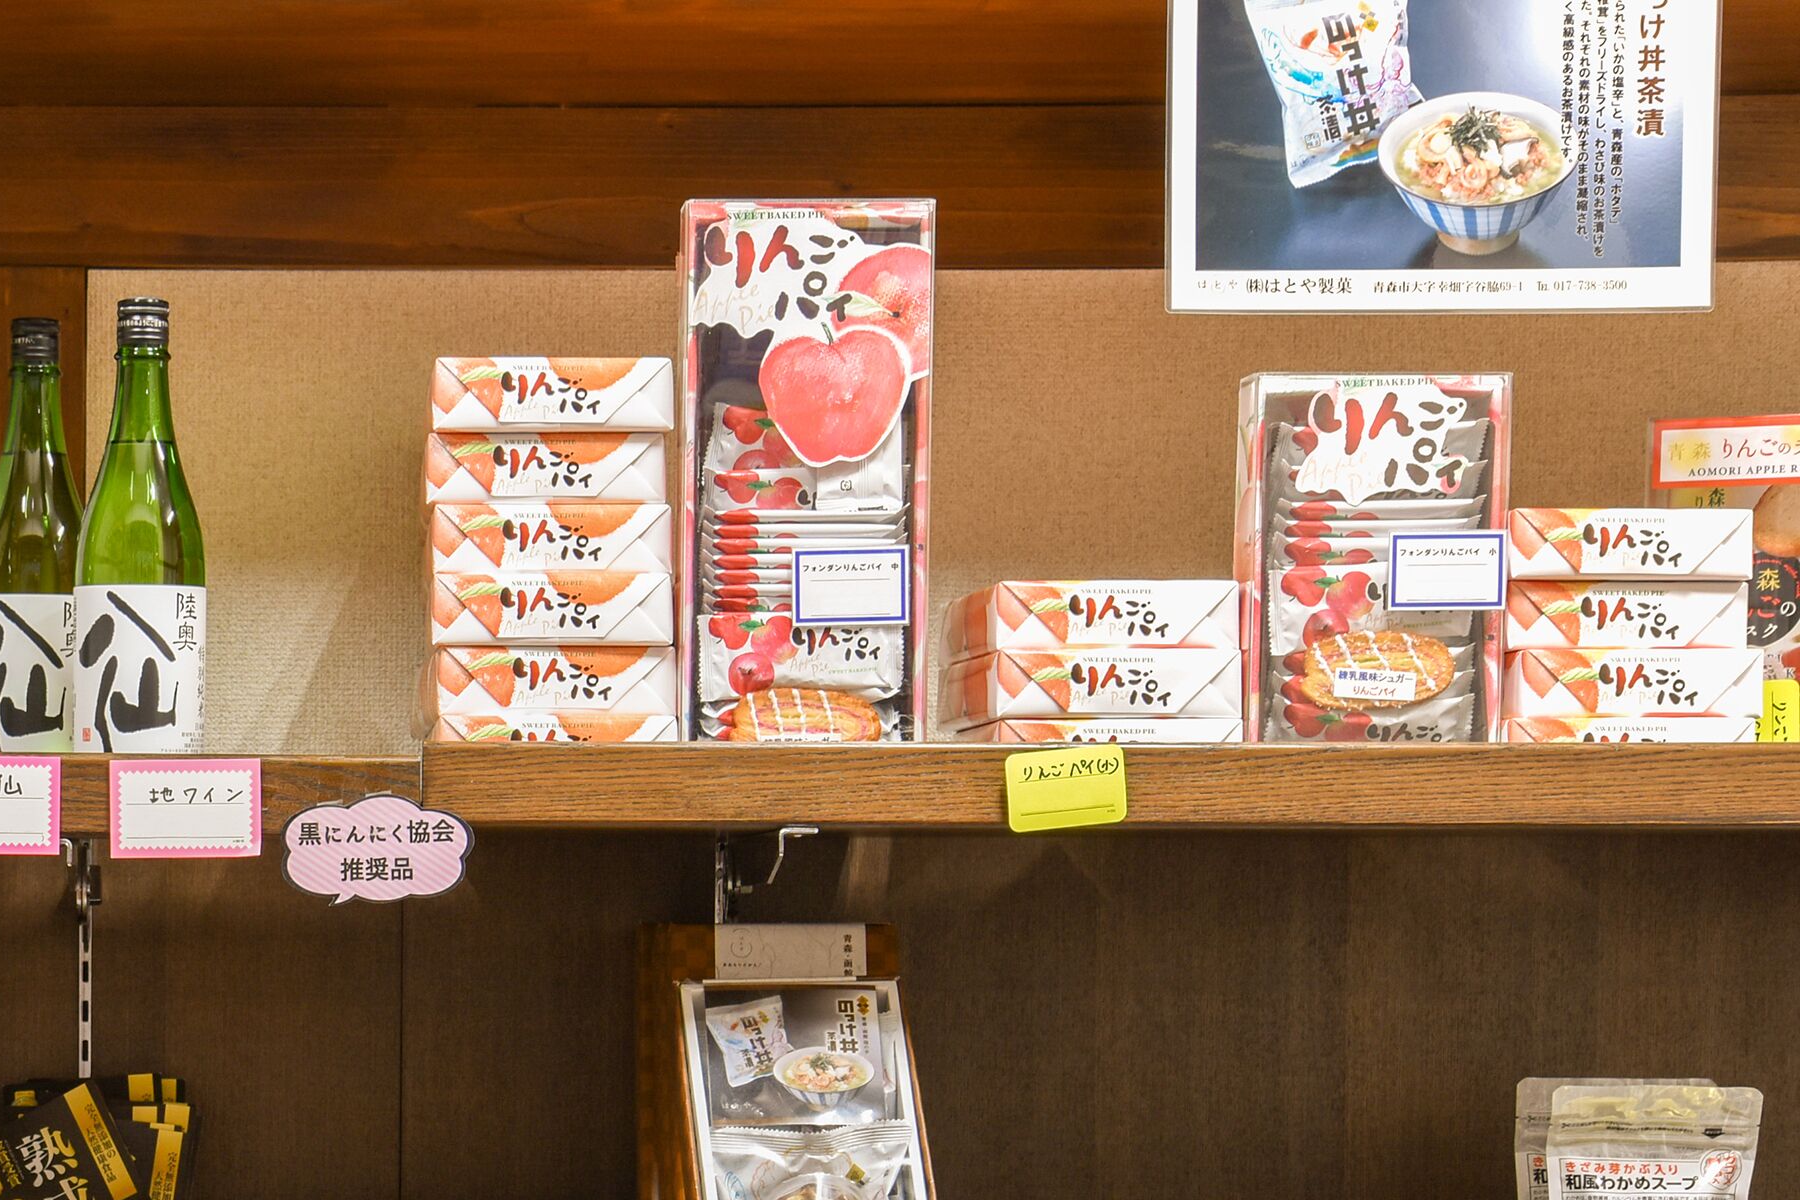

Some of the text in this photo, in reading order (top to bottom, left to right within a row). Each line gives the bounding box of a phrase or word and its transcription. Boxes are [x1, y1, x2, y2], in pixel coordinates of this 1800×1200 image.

[726, 210, 766, 221] SWEET
[766, 210, 806, 220] BAKED
[703, 224, 856, 323] りんごパイ
[1553, 279, 1628, 292] 017-738-3500
[1335, 379, 1375, 388] SWEET
[1375, 378, 1415, 387] BAKED
[1312, 391, 1465, 489] りんごパイ
[492, 445, 592, 489] りんごパイ
[1687, 465, 1743, 478] AOMORI
[1746, 464, 1788, 475] APPLE
[1488, 547, 1498, 557] 小
[1582, 523, 1683, 568] りんごパイ
[890, 562, 900, 572] 中
[1068, 593, 1170, 639] りんごパイ
[1580, 596, 1680, 640] りんごパイ
[1069, 662, 1172, 708] りんごパイ
[1338, 669, 1414, 685] 練乳風味シュガー
[1599, 663, 1699, 707] りんごパイ
[298, 819, 456, 848] 黒にんにく協会
[339, 855, 414, 883] 推奨品
[1564, 1174, 1699, 1191] 和風わかめスープ
[1565, 1162, 1680, 1176] きざみ芽かぶ入り
